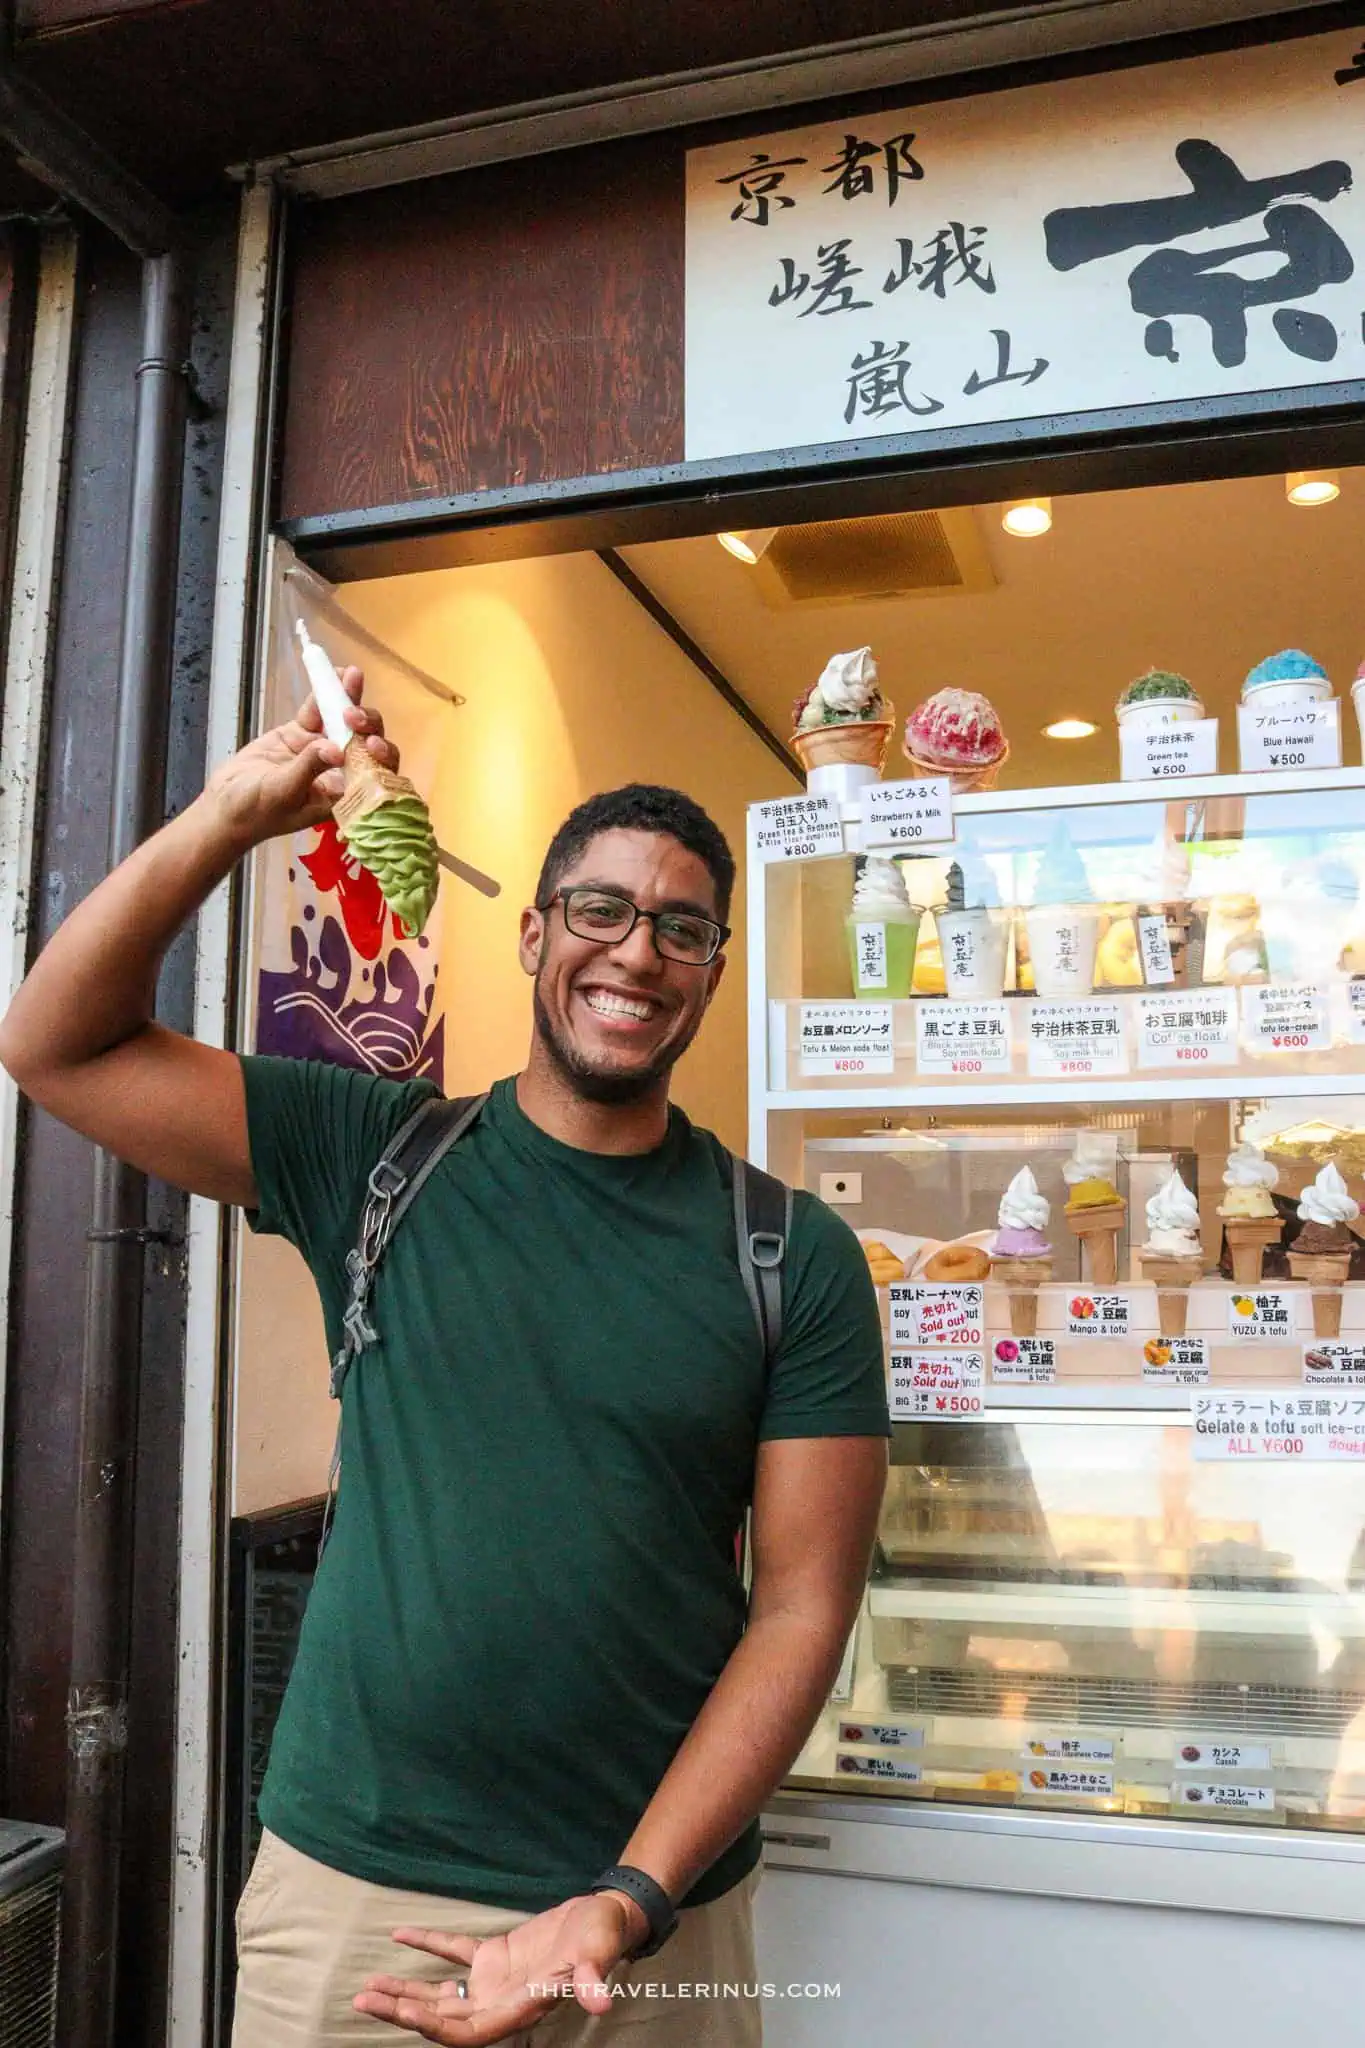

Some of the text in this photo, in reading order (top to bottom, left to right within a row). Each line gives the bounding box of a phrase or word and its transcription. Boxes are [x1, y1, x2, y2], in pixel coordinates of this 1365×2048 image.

[715, 132, 924, 225] 京都
[1043, 138, 1353, 368] 京
[768, 221, 997, 318] 嵯峨
[844, 330, 1049, 424] 嵐山
[1146, 732, 1195, 745] 宇治抹茶
[1263, 735, 1313, 746] Blue Hawaii
[1147, 753, 1172, 761] Green
[1270, 752, 1305, 766] ¥500
[1152, 764, 1186, 775] ¥500
[871, 786, 939, 802] いちごみるく
[760, 798, 828, 818] 宇治抹茶金時
[776, 812, 818, 828] 白玉入り
[870, 809, 941, 823] Strawberry & Milk
[758, 830, 780, 840] Green
[784, 828, 796, 836] tea
[890, 826, 922, 838] ¥600
[784, 843, 816, 856] ¥800
[1145, 1010, 1228, 1028] お豆腐珈琲
[803, 1024, 890, 1036] お豆腐メロンソーダ
[924, 1020, 1004, 1037] 黒ごま豆乳
[1032, 1019, 1120, 1038] 宇治抹茶豆乳
[1261, 1023, 1319, 1033] tofu ice-cream
[1272, 1034, 1309, 1047] ¥600
[803, 1045, 819, 1053] Tofu
[830, 1043, 850, 1052] Melon
[873, 1042, 889, 1051] float
[1176, 1048, 1208, 1059] ¥800
[834, 1060, 864, 1071] ¥800
[1061, 1061, 1092, 1072] ¥800
[890, 1288, 961, 1301] 豆乳ドーナツ
[1092, 1296, 1128, 1305] マンゴー
[1256, 1296, 1282, 1308] 柚子
[894, 1309, 910, 1319] soy
[921, 1301, 957, 1319] 売切れ
[1103, 1307, 1127, 1320] 豆腐
[1262, 1310, 1288, 1322] 豆腐
[920, 1313, 966, 1334] Sold out
[1070, 1324, 1127, 1334] Mango & tofu
[1232, 1325, 1287, 1335] YUZU & tofu
[896, 1330, 909, 1339] BIG
[1020, 1340, 1054, 1352] 紫いも
[1028, 1353, 1053, 1365] 豆腐
[1178, 1351, 1203, 1364] 豆腐
[917, 1362, 953, 1375] 売切れ
[895, 1379, 911, 1388] soy
[913, 1375, 960, 1389] Sold out
[1184, 1375, 1199, 1383] tofu
[1306, 1376, 1344, 1384] Chocolate
[896, 1396, 909, 1406] BIG
[936, 1395, 980, 1411] ¥500
[1250, 1422, 1259, 1433] &
[1265, 1419, 1295, 1434] tofu
[1228, 1438, 1257, 1453] ALL
[1212, 1747, 1240, 1757] カシス
[1207, 1786, 1265, 1799] チョコレート
